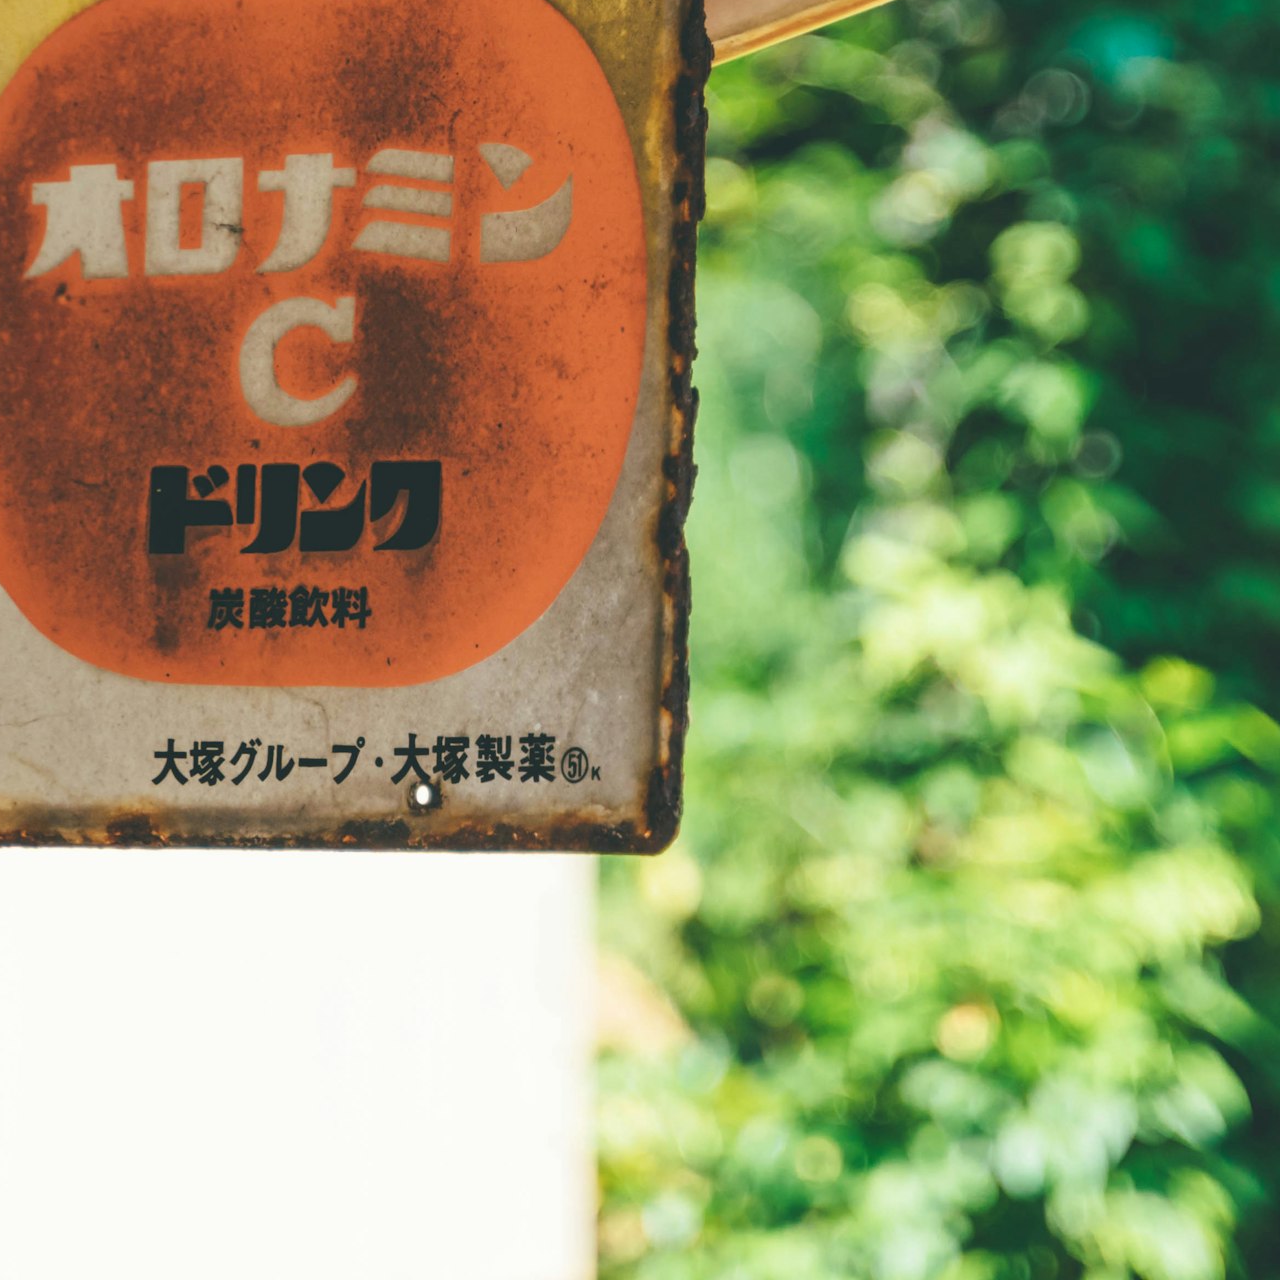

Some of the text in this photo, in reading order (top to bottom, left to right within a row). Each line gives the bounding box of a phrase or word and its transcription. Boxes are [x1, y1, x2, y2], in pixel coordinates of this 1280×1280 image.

[22, 142, 573, 280] オロナミン
[238, 296, 358, 428] C
[147, 460, 442, 555] ドリンク
[206, 584, 373, 631] 炭酸飲料
